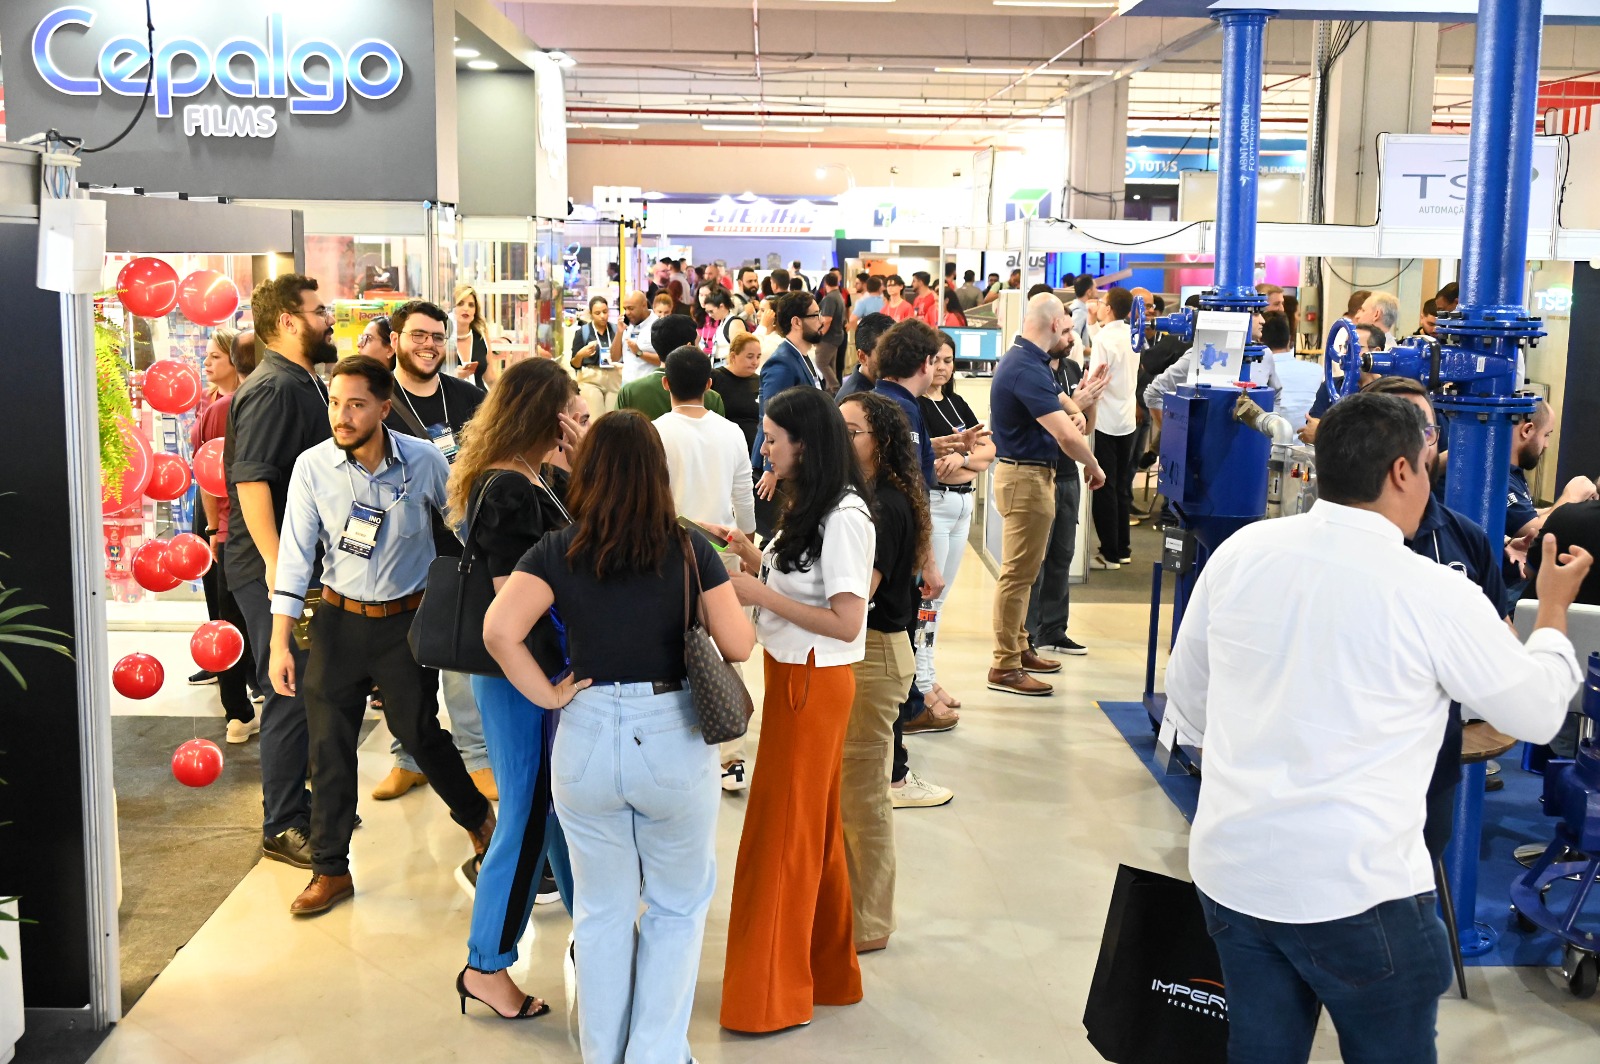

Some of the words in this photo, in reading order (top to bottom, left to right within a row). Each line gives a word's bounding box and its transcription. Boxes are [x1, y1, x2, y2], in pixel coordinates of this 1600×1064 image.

[32, 5, 404, 118] Cepalgo
[184, 104, 278, 138] FILMS
[1240, 104, 1251, 144] CARBON
[1239, 148, 1249, 172] ABNT
[1418, 204, 1465, 216] AUTOMAÇÃ
[1006, 252, 1047, 268] alus
[1167, 998, 1230, 1022] FERRAMEN
